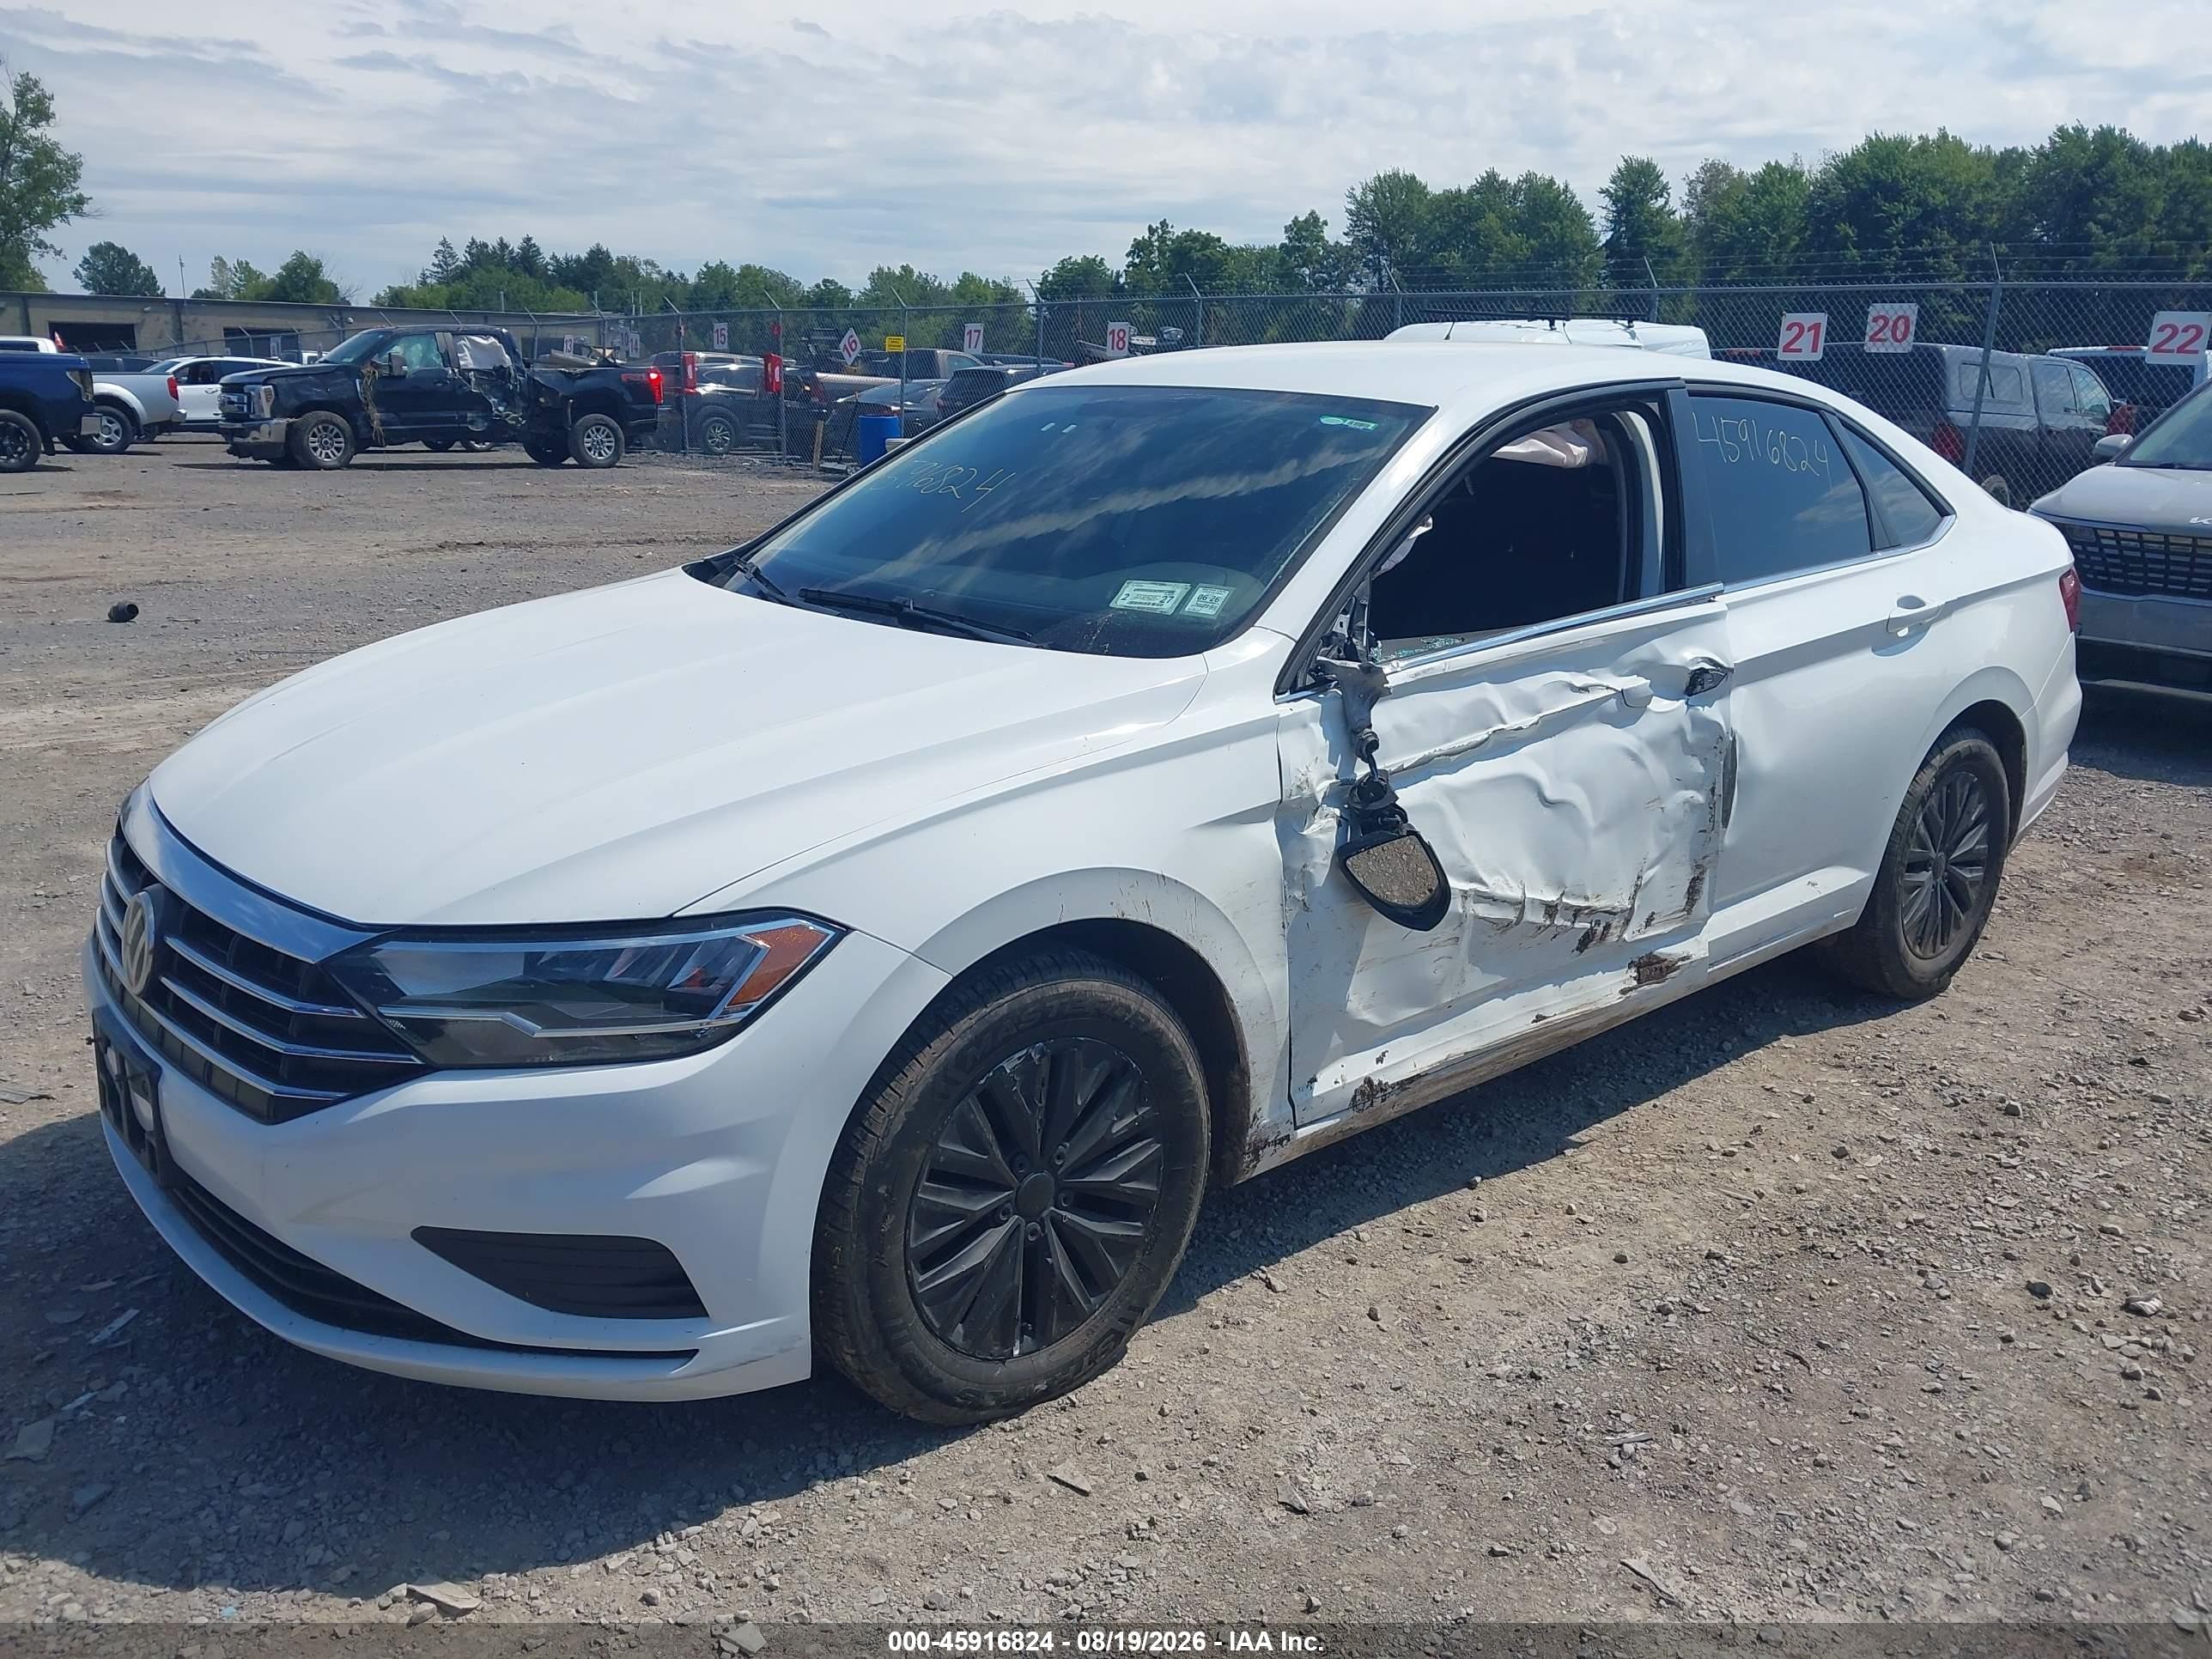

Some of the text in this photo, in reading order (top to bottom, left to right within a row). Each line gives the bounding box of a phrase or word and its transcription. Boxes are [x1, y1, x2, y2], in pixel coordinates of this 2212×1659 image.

[714, 328, 726, 345] 15
[966, 329, 981, 349] 17
[1108, 328, 1127, 350] 18
[1782, 321, 1822, 353] 21
[1869, 314, 1911, 343] 20
[2152, 323, 2204, 354] 22
[565, 338, 573, 353] 13
[842, 335, 858, 358] 16
[1692, 412, 1833, 489] 45916824
[1159, 595, 1175, 604] 27
